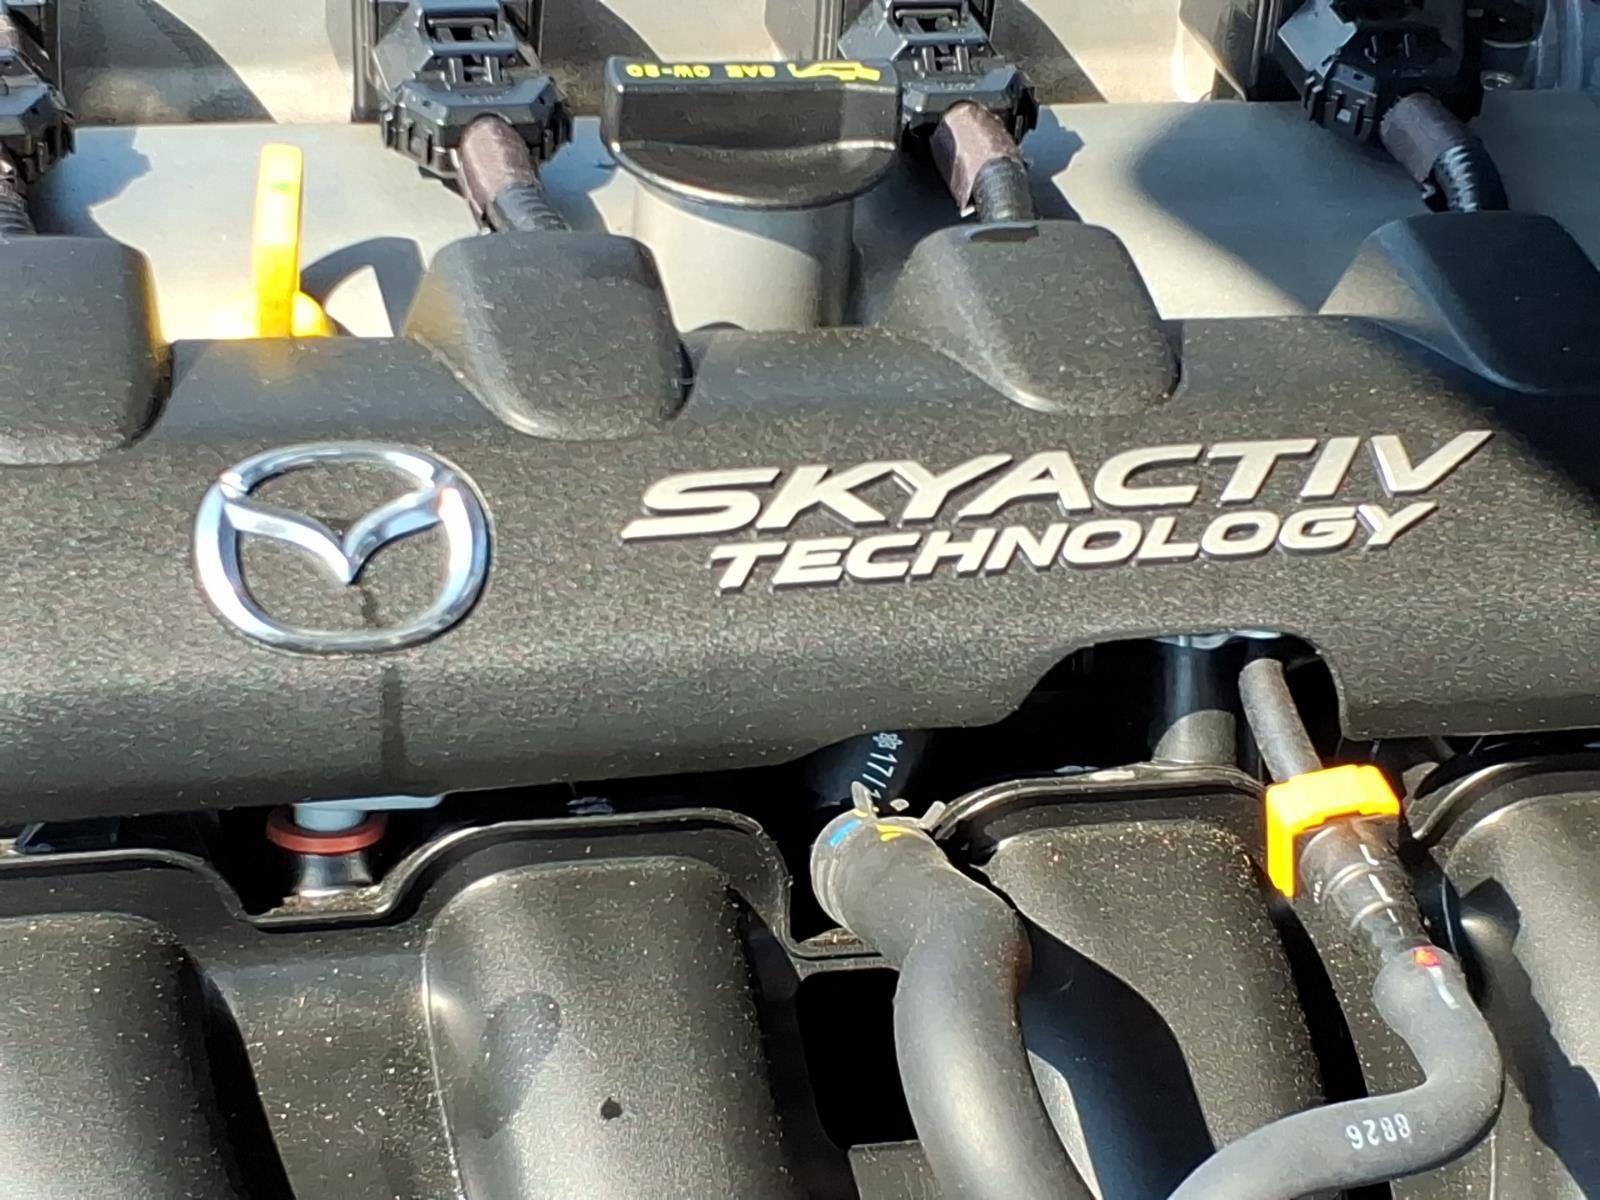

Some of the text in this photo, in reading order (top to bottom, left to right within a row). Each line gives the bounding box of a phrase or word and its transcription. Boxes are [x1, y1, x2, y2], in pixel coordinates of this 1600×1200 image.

[621, 430, 1494, 541] SKYACTIV
[708, 501, 1438, 592] TECHNOLOGY
[1345, 1113, 1411, 1150] 8826
